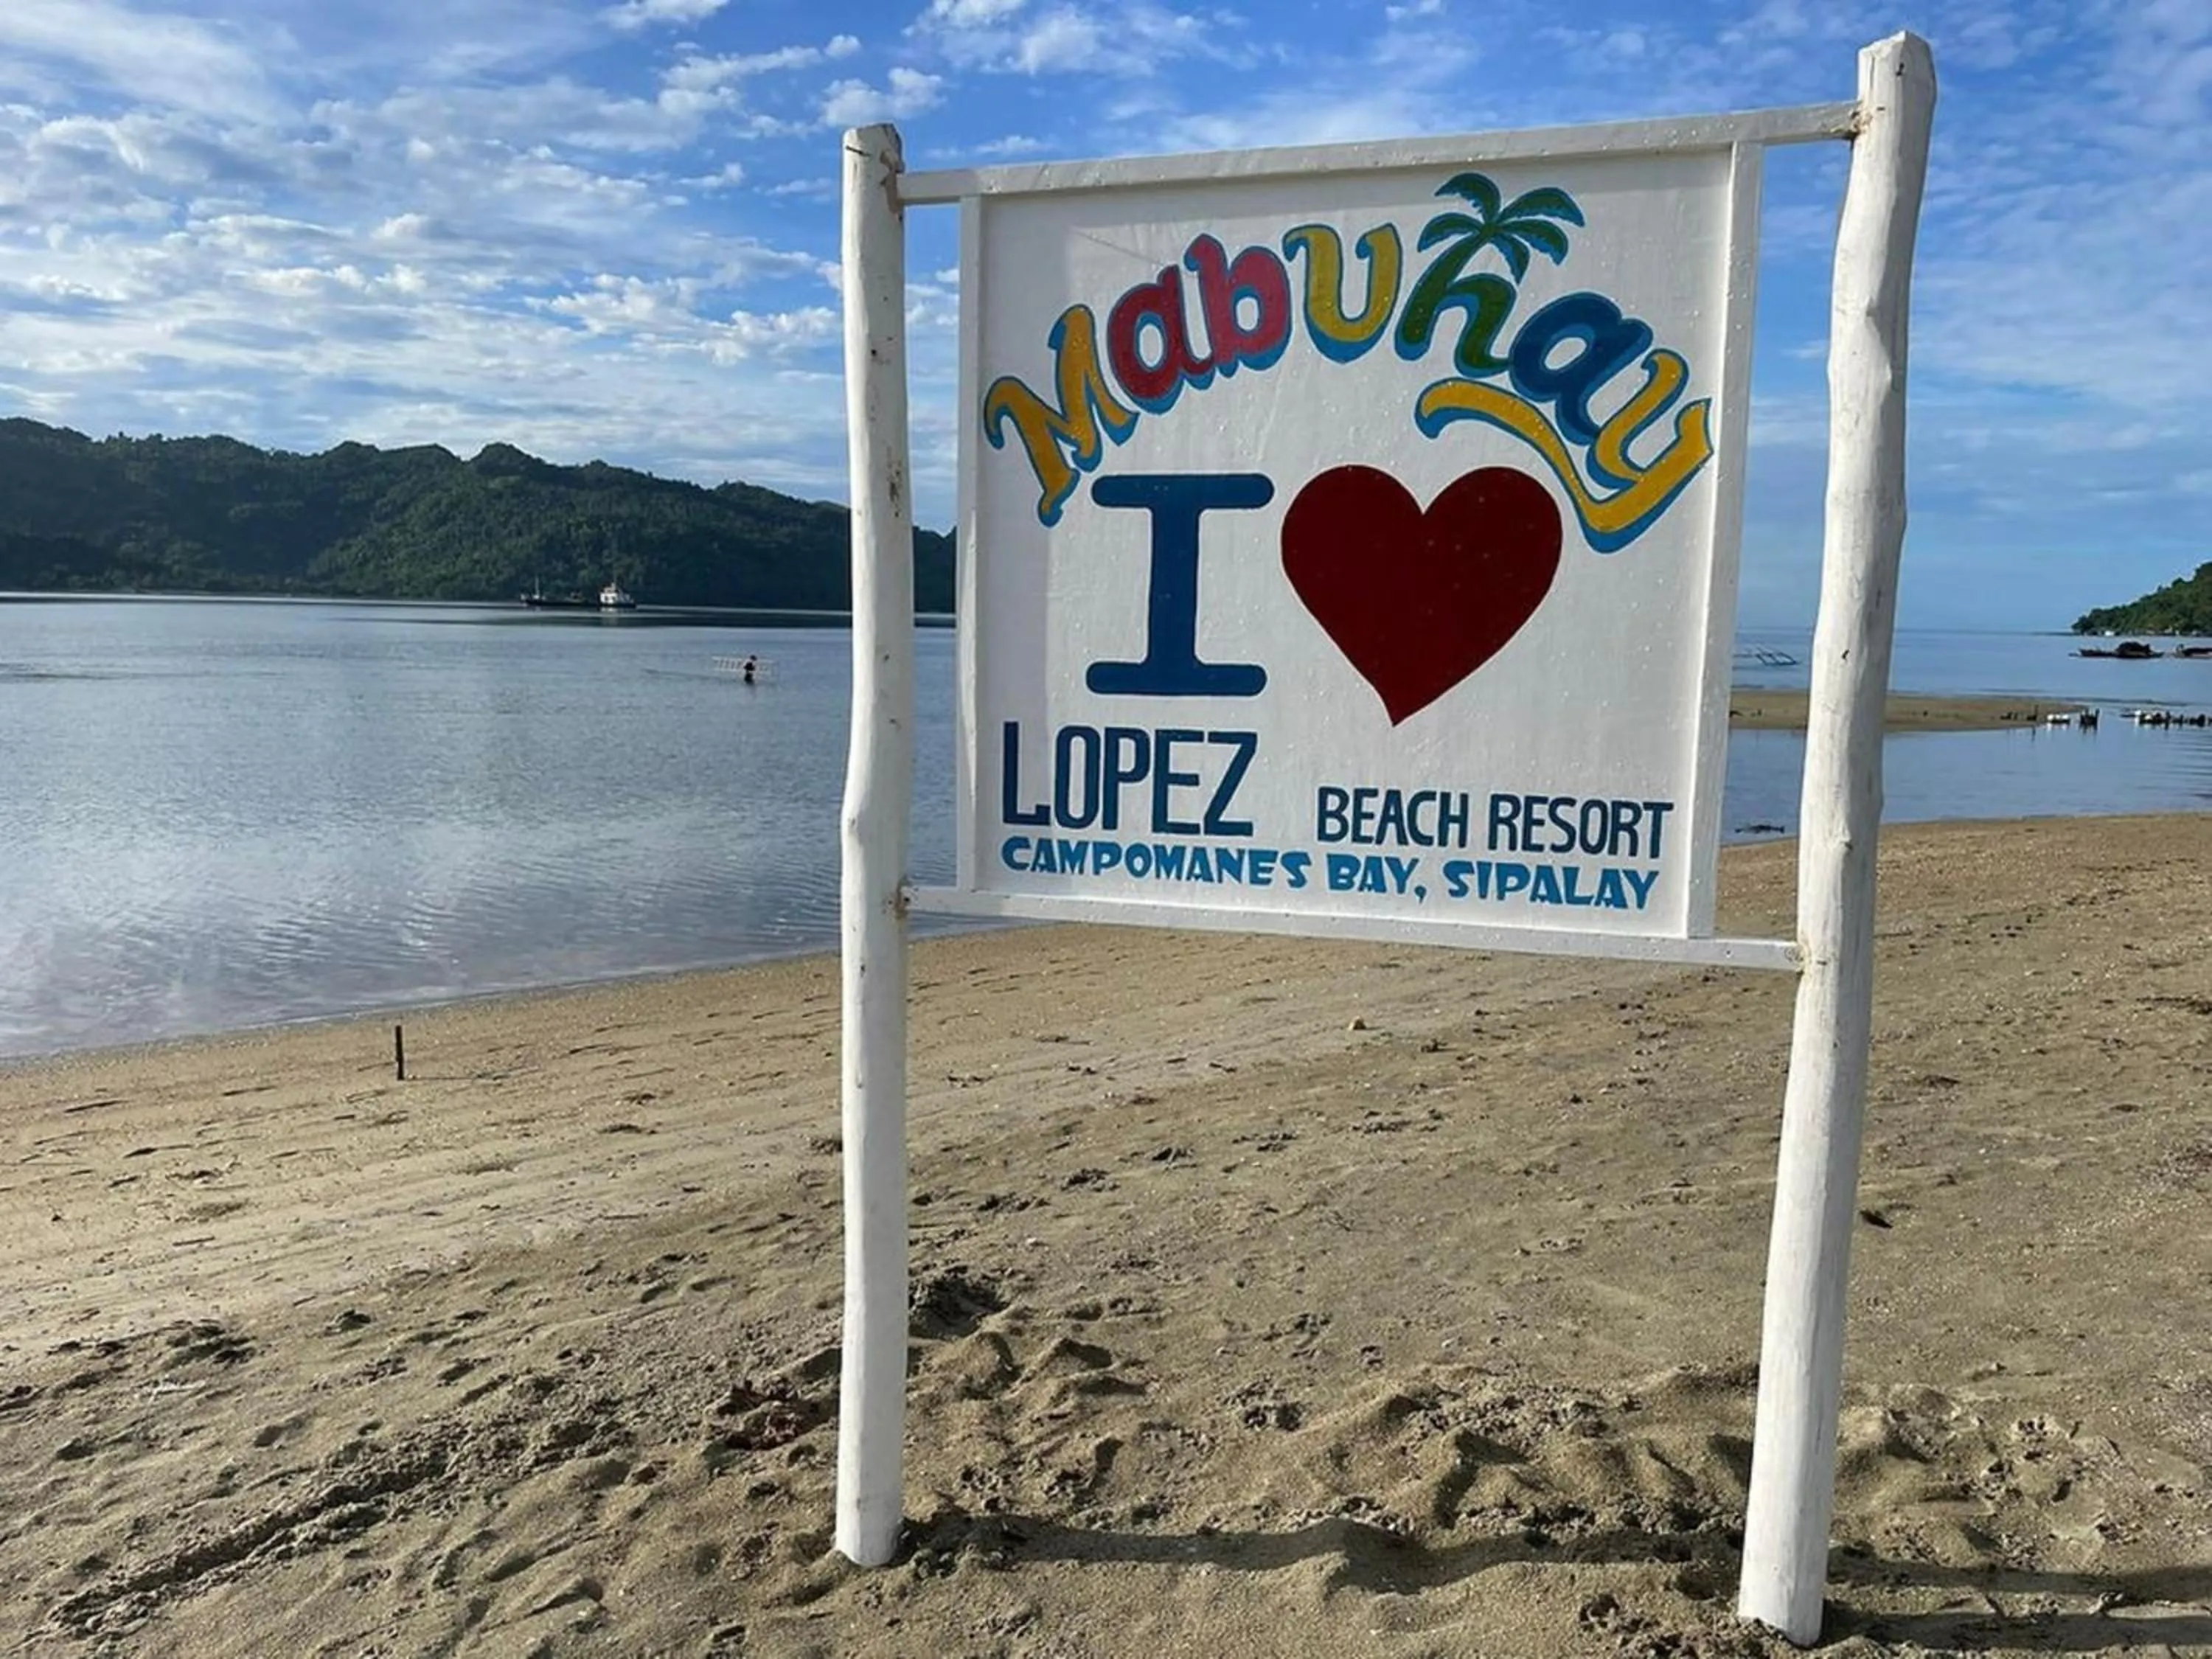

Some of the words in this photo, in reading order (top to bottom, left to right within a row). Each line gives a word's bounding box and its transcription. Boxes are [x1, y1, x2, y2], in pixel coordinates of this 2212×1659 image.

[984, 172, 1714, 552] Mabuhay
[1085, 473, 1274, 697] I
[1001, 835, 1312, 889] CAMPOMANES
[1326, 852, 1427, 904] BAY,
[1442, 860, 1660, 910] SIPALAY
[1003, 721, 1258, 837] LOPEZ
[1317, 786, 1469, 849] BEACH
[1487, 793, 1674, 859] RESORT
